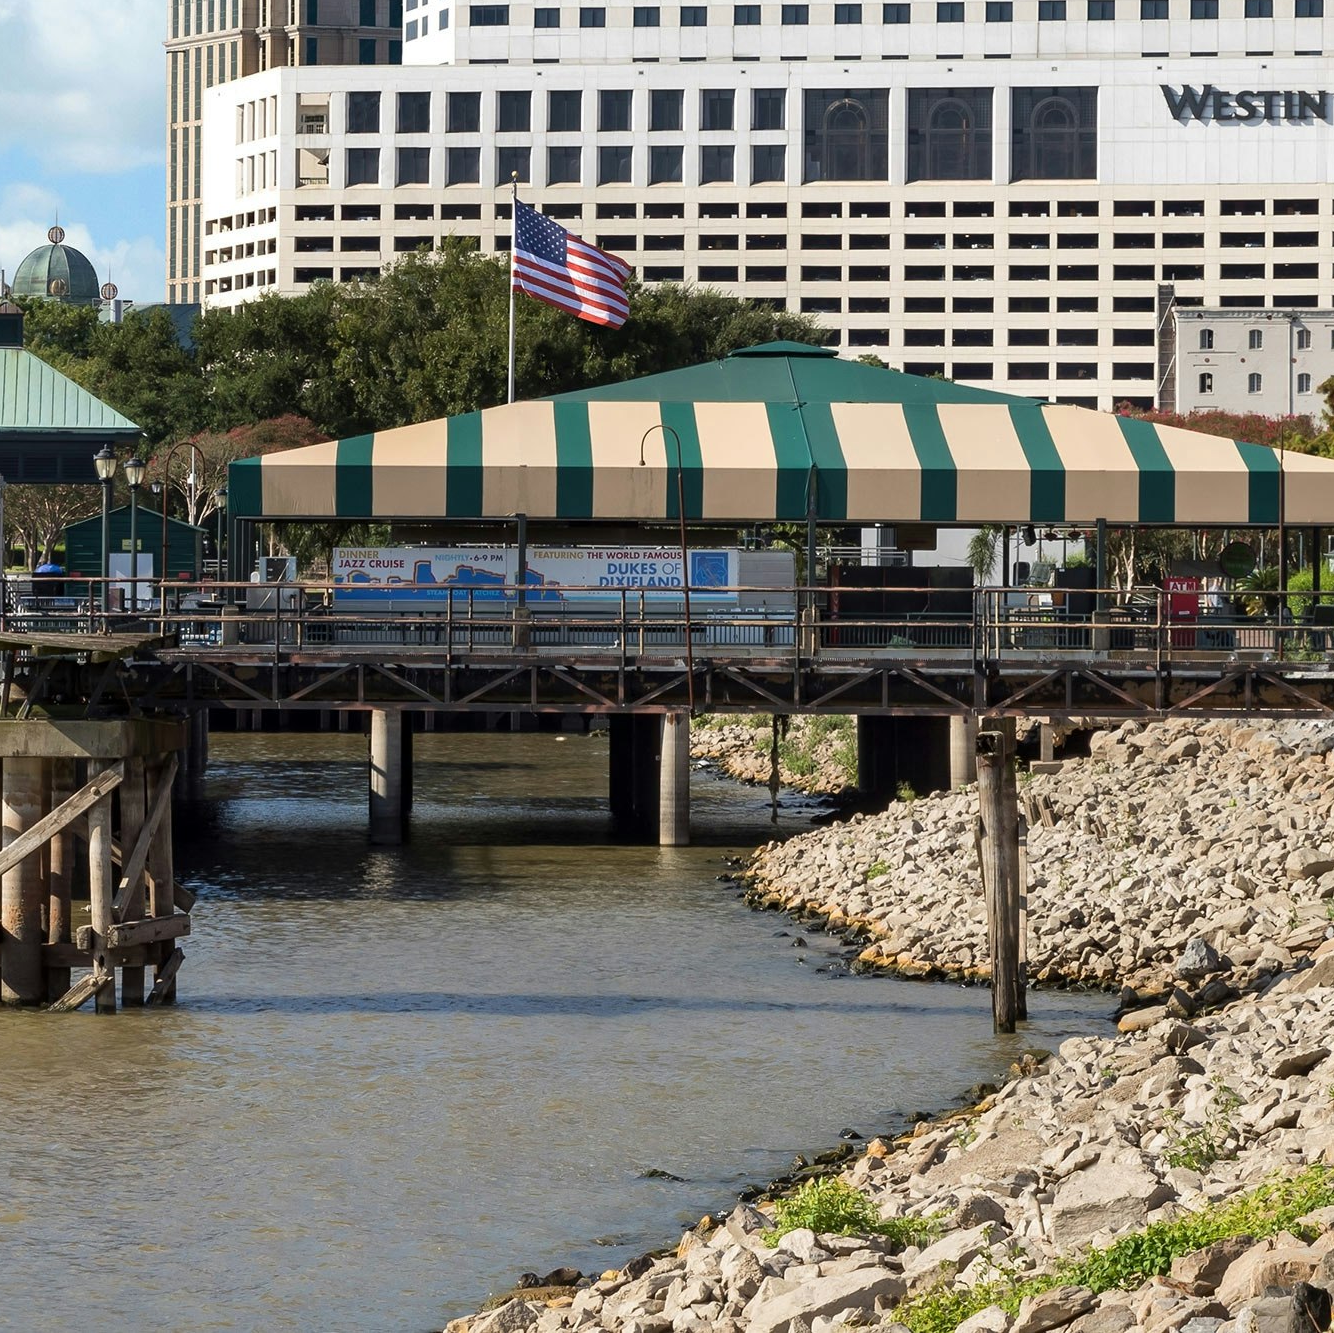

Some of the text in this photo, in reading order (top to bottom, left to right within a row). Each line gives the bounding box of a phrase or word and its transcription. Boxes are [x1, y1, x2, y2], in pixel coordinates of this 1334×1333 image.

[534, 551, 584, 559] FEATURING
[339, 560, 404, 568] JAZZ CRUISE
[608, 563, 681, 575] DUKES OF
[599, 576, 681, 586] DIXIELAND
[1169, 582, 1195, 591] ATM
